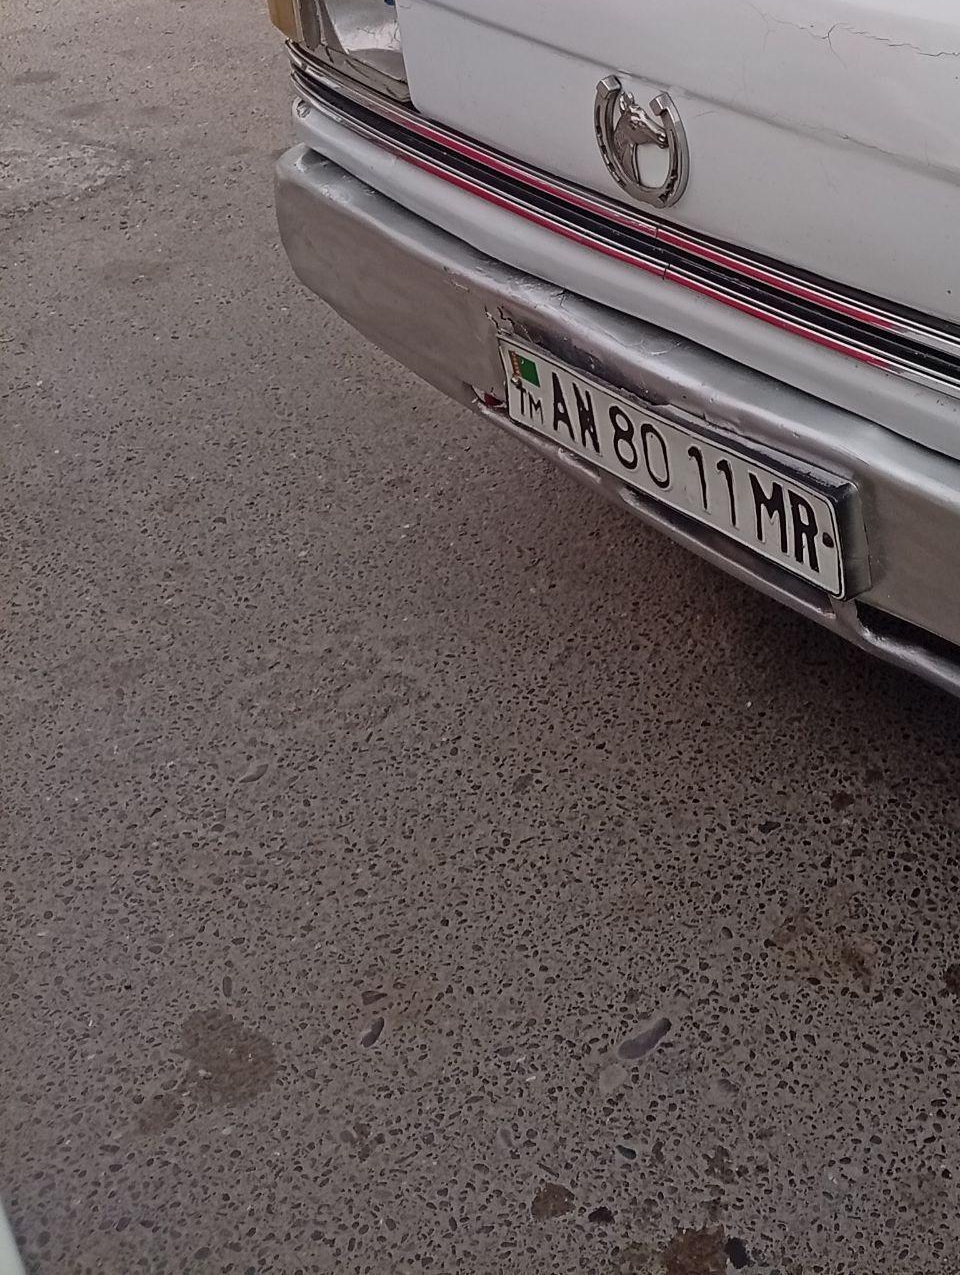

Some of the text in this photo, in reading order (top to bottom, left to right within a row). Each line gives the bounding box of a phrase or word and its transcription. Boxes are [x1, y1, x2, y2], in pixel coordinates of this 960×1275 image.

[518, 386, 543, 424] TM
[551, 371, 600, 454] AN
[748, 471, 820, 573] MR
